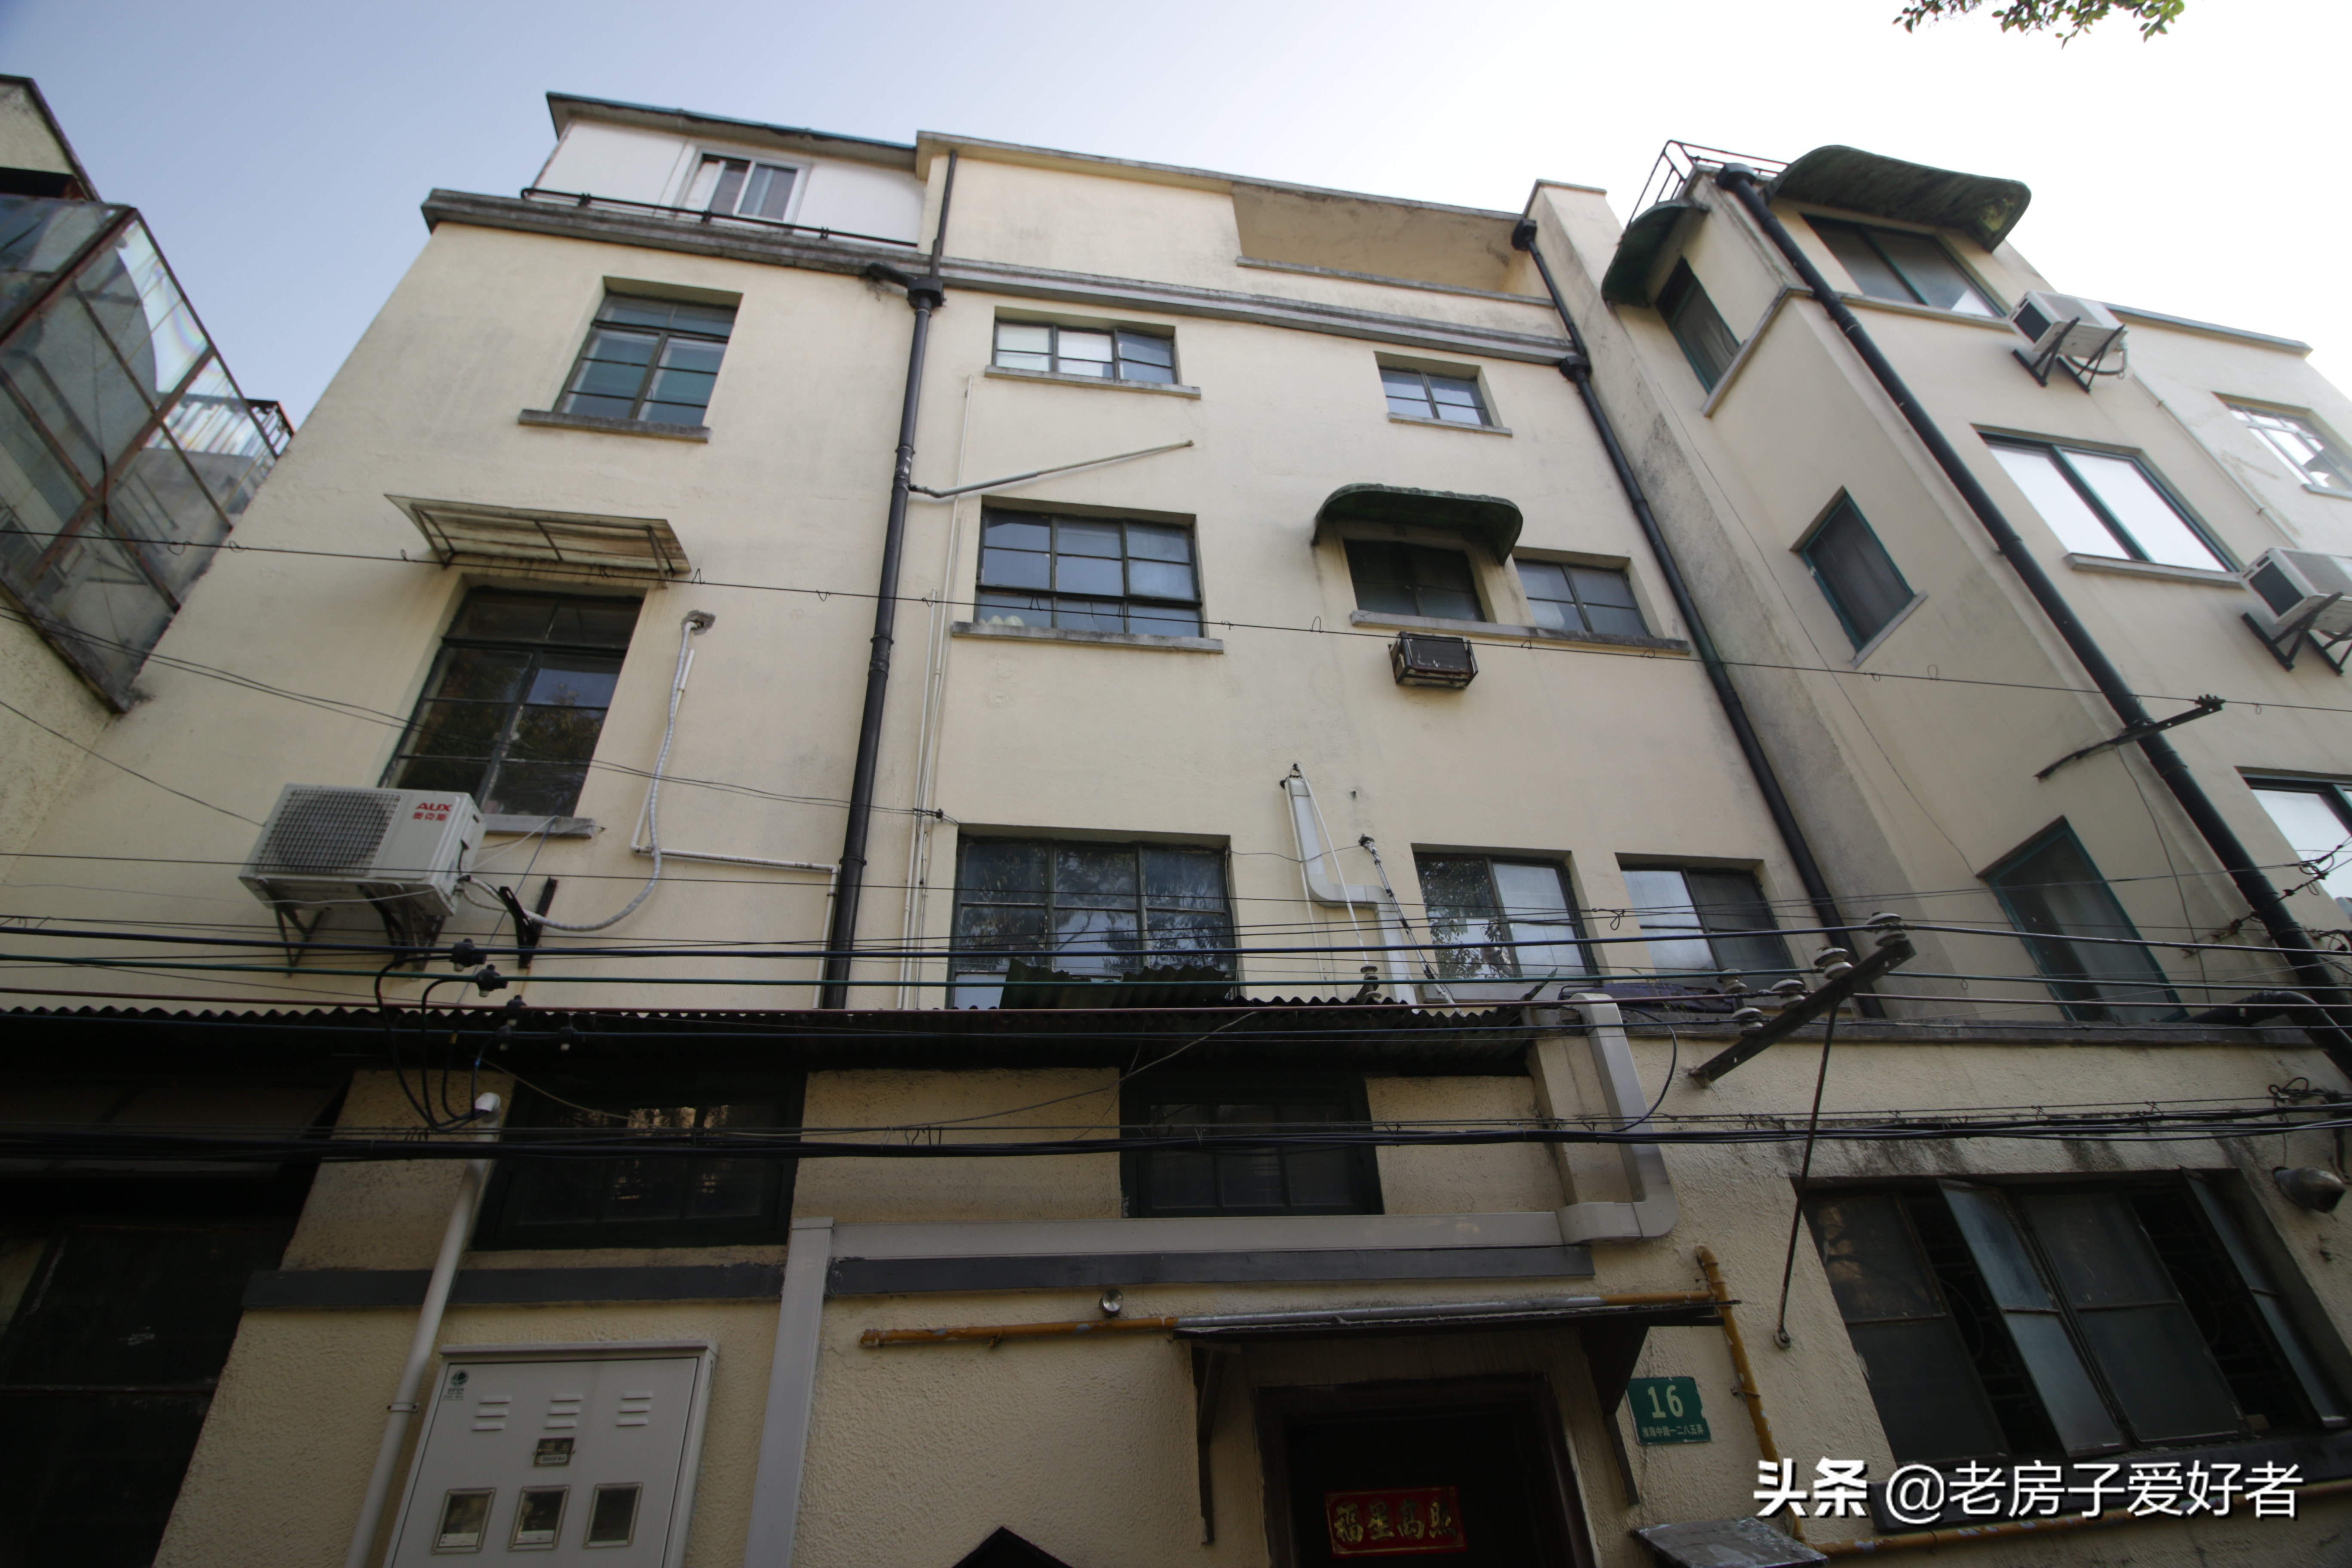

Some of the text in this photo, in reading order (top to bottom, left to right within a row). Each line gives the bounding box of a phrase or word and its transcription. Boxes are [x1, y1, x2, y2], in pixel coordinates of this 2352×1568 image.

[416, 802, 452, 812] AUX
[1647, 1385, 1684, 1418] 16
[1641, 1424, 1704, 1437] 淮海中路一二八五弄
[1334, 1499, 1457, 1543] 福星高照
